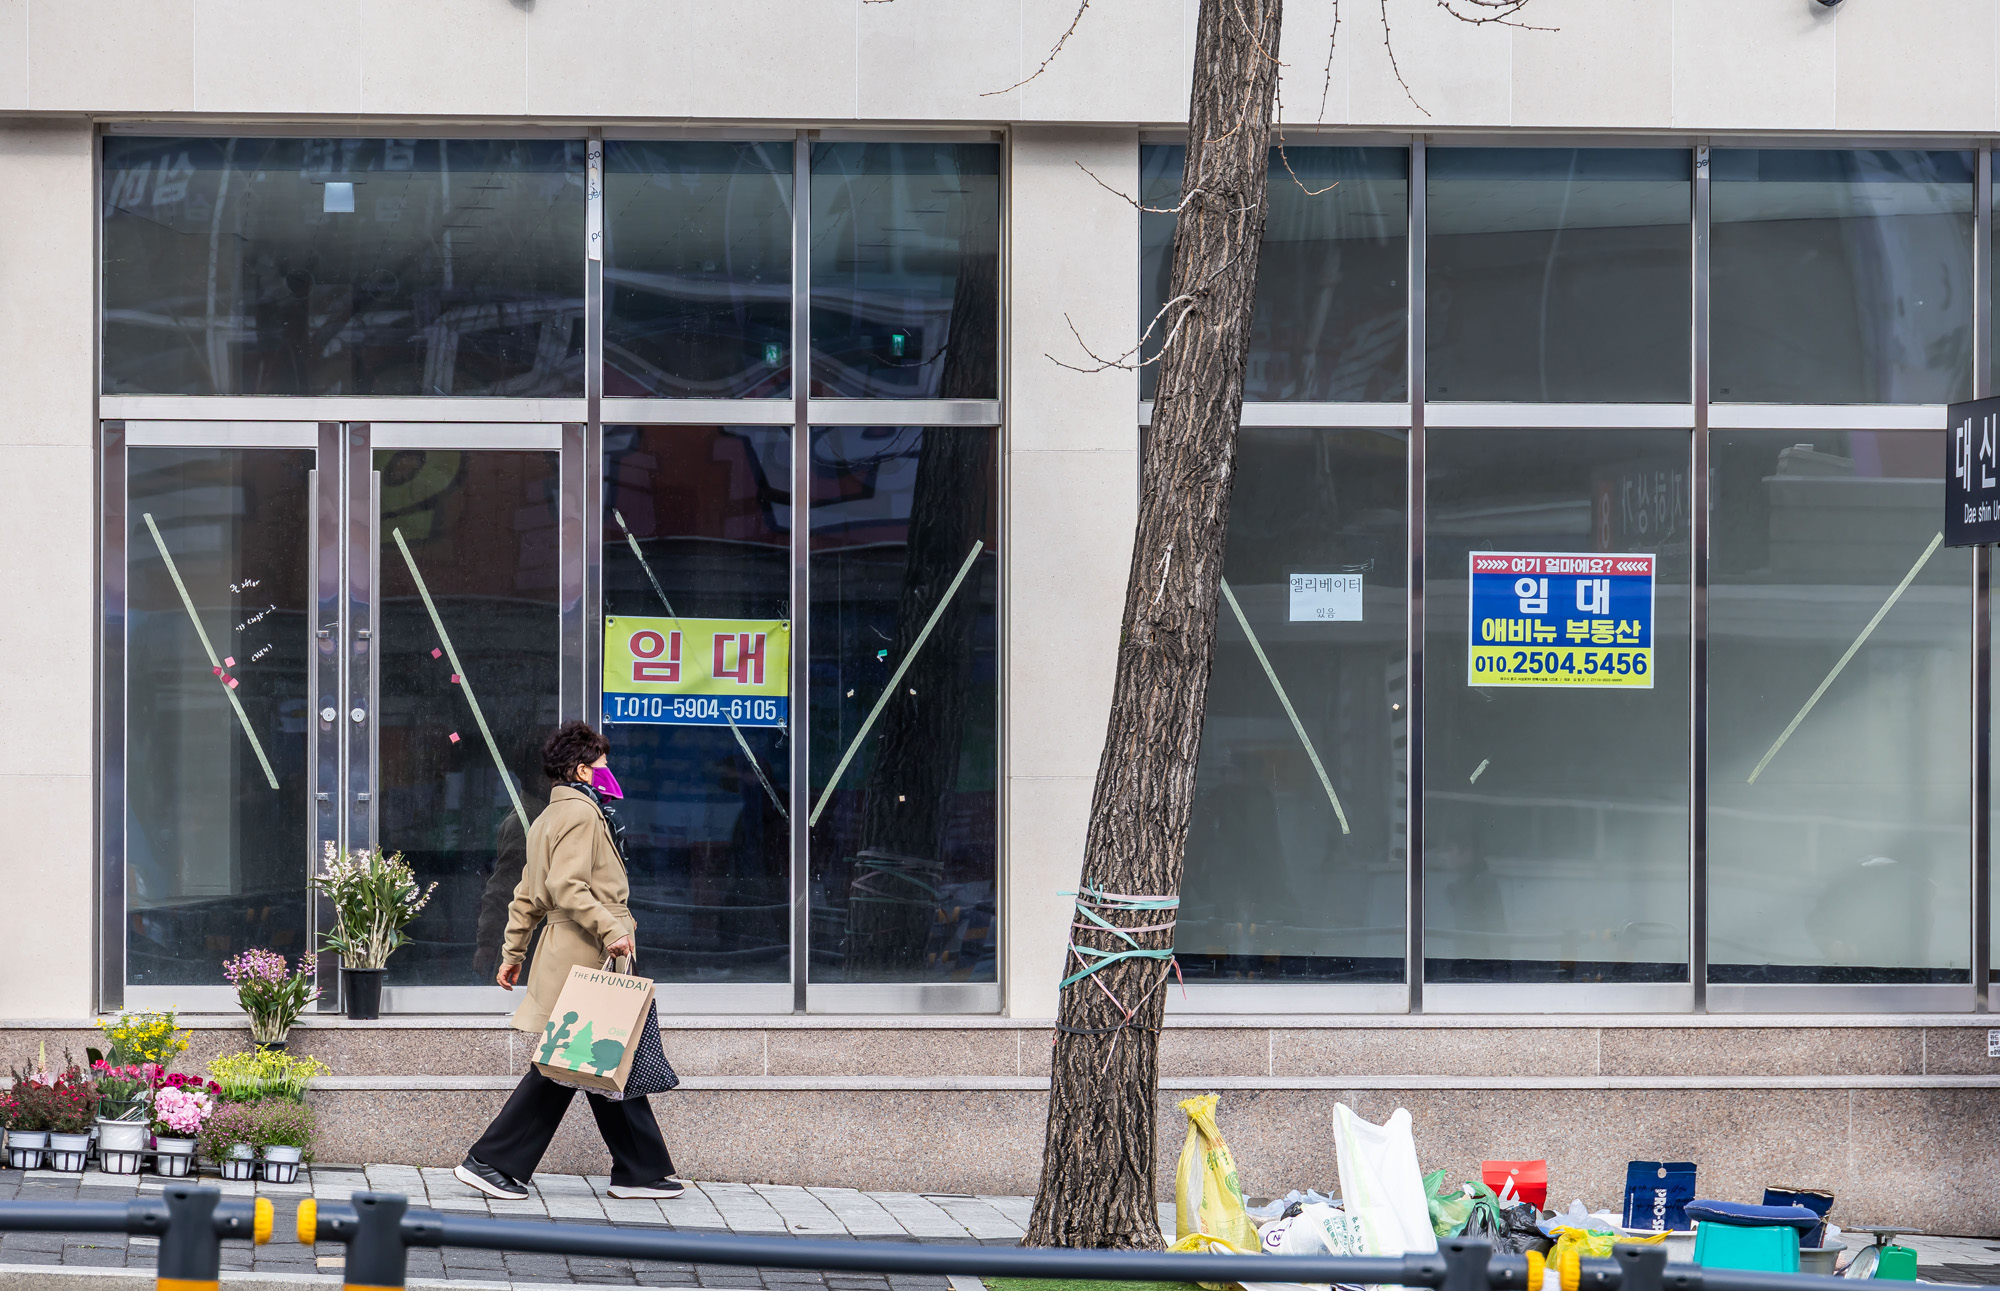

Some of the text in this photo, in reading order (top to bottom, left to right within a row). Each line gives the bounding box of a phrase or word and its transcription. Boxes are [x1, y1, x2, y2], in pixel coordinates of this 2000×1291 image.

[1964, 503, 1977, 524] Dae
[1978, 500, 1992, 522] shin
[1511, 558, 1614, 574] 여기 얼마에요?
[1290, 577, 1361, 593] 엘리베이터
[1316, 607, 1336, 619] 있음
[1481, 617, 1642, 644] 애비뉴 부동산
[1475, 651, 1648, 675] 010.2504.5456
[614, 697, 777, 720] T.010-5904-6105
[573, 971, 648, 992] THE HYUNDAI
